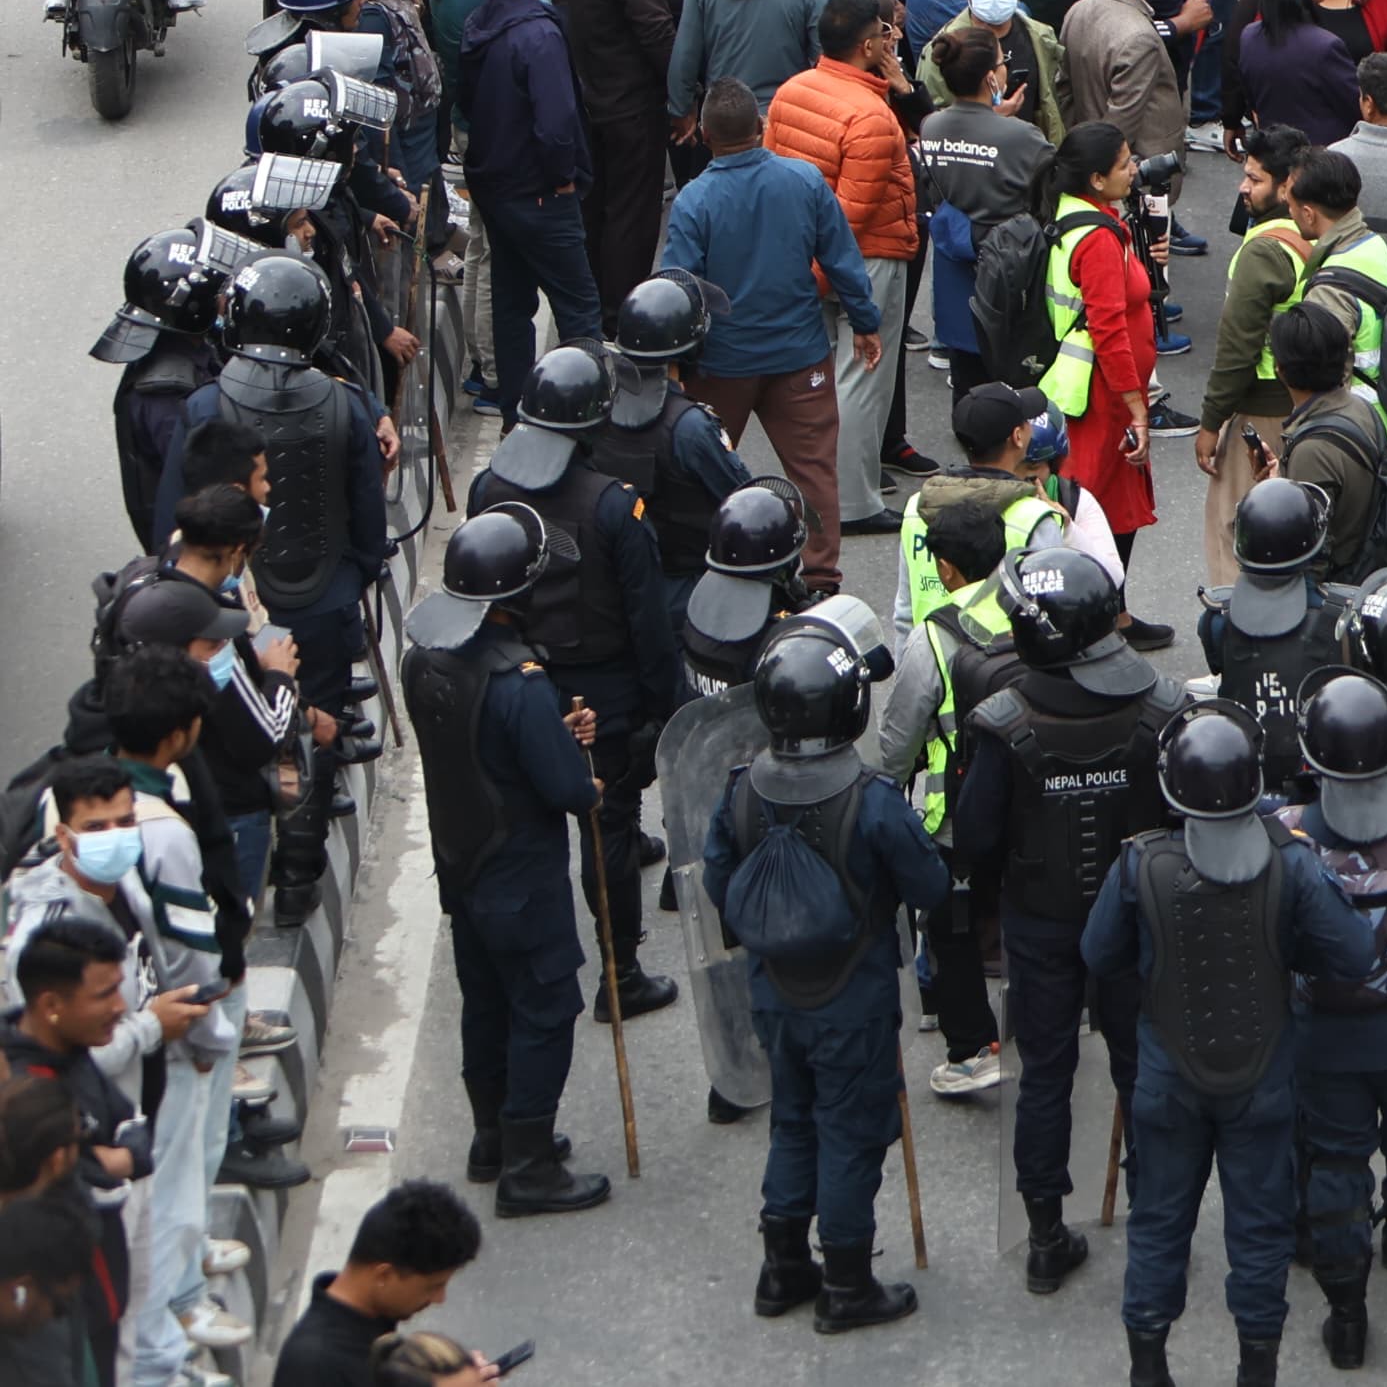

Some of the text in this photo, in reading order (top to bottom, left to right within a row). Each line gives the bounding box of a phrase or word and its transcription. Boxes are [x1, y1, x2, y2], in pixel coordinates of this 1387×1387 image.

[303, 98, 329, 109] NEP
[944, 138, 999, 158] balance
[222, 199, 253, 212] POLIC
[170, 243, 196, 255] NEP
[1022, 569, 1064, 586] NEPAL
[826, 647, 848, 666] NEP
[1045, 769, 1127, 790] NEPAL POLICE
